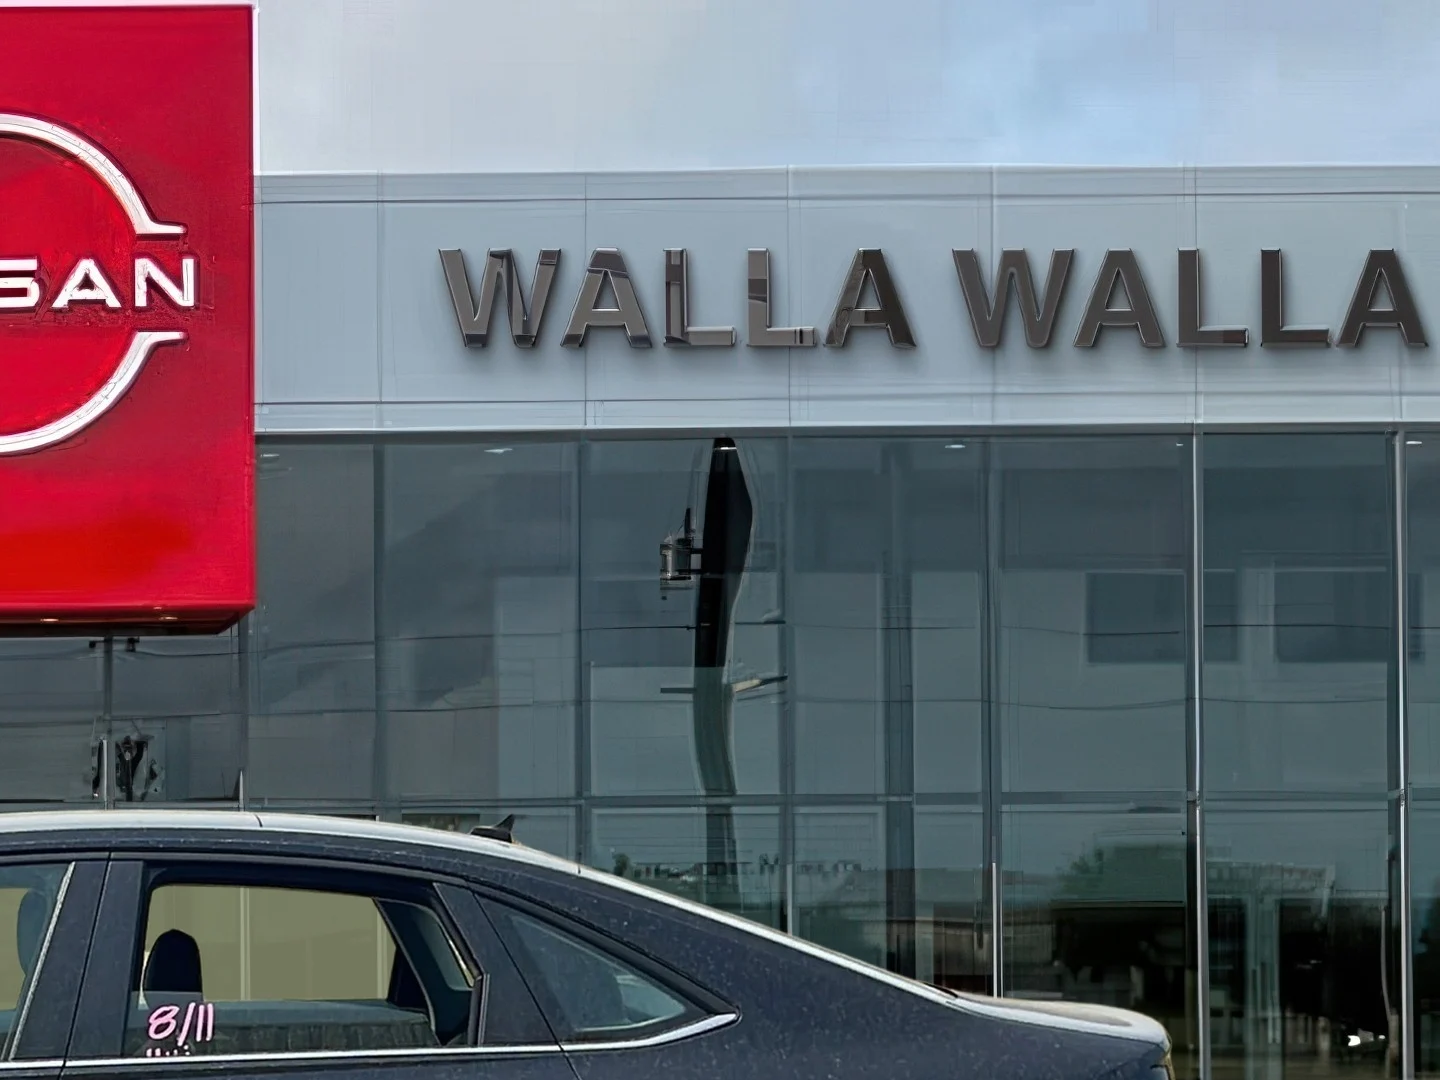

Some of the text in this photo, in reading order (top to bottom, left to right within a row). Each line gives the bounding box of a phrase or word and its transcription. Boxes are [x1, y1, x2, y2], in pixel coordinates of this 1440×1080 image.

[438, 247, 1429, 348] WALLA WALLA
[148, 1002, 214, 1046] 8/11
